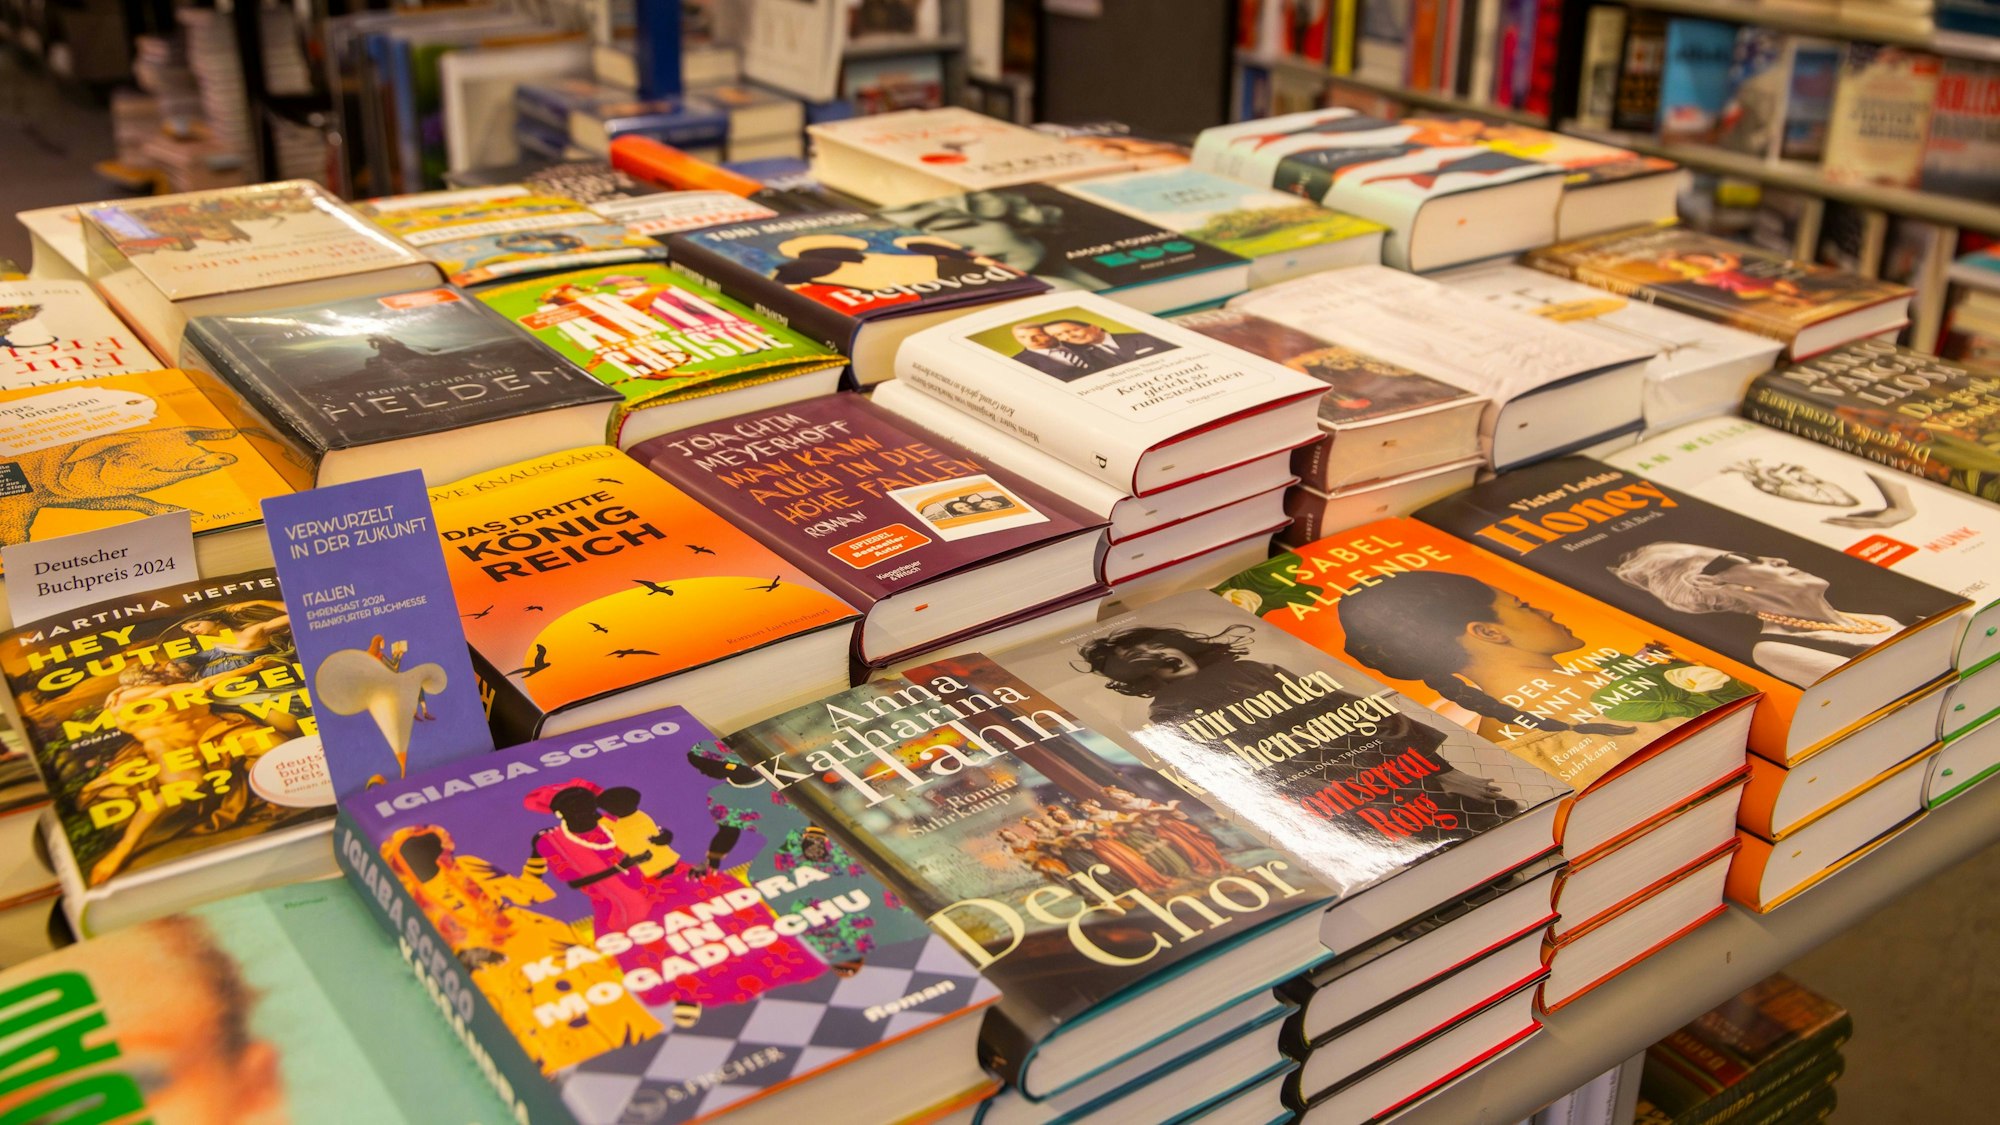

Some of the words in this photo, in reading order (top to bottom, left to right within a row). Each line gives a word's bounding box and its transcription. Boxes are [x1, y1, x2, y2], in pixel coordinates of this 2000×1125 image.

[705, 227, 758, 243] TONI
[762, 211, 868, 234] MORRISON
[827, 265, 1016, 307] Beloved
[6, 336, 124, 361] Frei
[16, 352, 126, 375] Für
[599, 324, 793, 378] CHRISTIE
[1117, 377, 1152, 396] Kein
[1154, 362, 1209, 383] Grund,
[1131, 370, 1245, 412] rumzuschreien
[1144, 378, 1189, 398] gleich
[1192, 372, 1208, 381] so
[0, 418, 89, 443] warzbrenner
[92, 410, 120, 423] und
[15, 396, 100, 419] Jonasson
[20, 411, 82, 431] verliebte
[1751, 408, 1799, 438] LLOSA
[1757, 388, 1846, 438] Versuchung
[9, 439, 38, 450] wie
[41, 435, 55, 444] er
[57, 429, 80, 443] die
[81, 418, 117, 438] Welt
[119, 413, 146, 426] sah
[667, 411, 808, 459] JOACHIM
[694, 419, 849, 473] MEYERHOFF
[1804, 428, 1864, 456] VARGAS
[1850, 424, 1902, 449] große
[1902, 439, 1931, 465] Die
[474, 447, 616, 494] KNAUSGÅRD
[718, 458, 798, 491] MAN
[797, 434, 886, 476] KANN
[747, 468, 832, 506] AUCH
[839, 459, 882, 487] IN
[883, 442, 946, 466] DIE
[1312, 444, 1322, 475] HANSER
[1869, 450, 1926, 477] MARIO
[773, 482, 864, 526] HÖHE
[856, 456, 988, 499] FALLEN
[1509, 487, 1567, 512] Victor
[1563, 470, 1624, 495] Lodato
[284, 504, 395, 541] VERWURZELT
[441, 520, 508, 541] DAS
[509, 490, 616, 527] DRITTE
[457, 504, 641, 563] KÖNIG
[804, 510, 868, 538] ROMAN
[1474, 480, 1679, 556] Honey
[290, 544, 310, 560] IN
[314, 534, 351, 556] DER
[355, 516, 428, 547] ZUKUNFT
[480, 522, 668, 583] REICH
[849, 531, 894, 551] SPIEGEL
[852, 534, 909, 559] Bestseller-
[874, 543, 905, 557] Autor
[1562, 531, 1608, 553] Roman
[1923, 526, 1981, 553] MUNK
[34, 547, 129, 576] Deutscher
[36, 569, 129, 597] Buchpreis
[133, 556, 176, 578] 2024
[876, 560, 922, 581] Kiepenheuer
[1271, 535, 1403, 587] ISABEL
[302, 583, 356, 608] ITALIEN
[1287, 545, 1452, 620] ALLENDE
[1957, 578, 1990, 599] EYNE
[18, 599, 171, 648] MARTINA
[306, 599, 360, 621] EHRENGAST
[361, 594, 386, 607] 2024
[308, 608, 372, 631] FRANKFURTER
[373, 595, 428, 616] BUCHMESSE
[726, 628, 763, 646] Roman
[764, 607, 831, 636] Luchterhand
[26, 624, 137, 672] HEY
[37, 628, 239, 691] GUTEN
[1497, 687, 1581, 741] KENNT
[1581, 649, 1675, 690] MEINEN
[1502, 677, 1556, 709] DER
[1553, 647, 1620, 677] WIND
[240, 687, 313, 721] WI
[824, 673, 969, 735] Anna
[1179, 709, 1237, 744] wir
[1226, 689, 1294, 725] von
[1283, 669, 1346, 707] den
[1568, 676, 1660, 723] NAMEN
[70, 730, 122, 751] ROMAN
[753, 684, 1031, 792] Katharina
[1290, 692, 1401, 750] sangen
[108, 725, 276, 787] GEHT
[297, 716, 319, 736] E
[275, 752, 326, 772] deuts
[278, 762, 320, 780] buch
[374, 760, 539, 818] IGIABA
[539, 720, 682, 769] SCEGO
[832, 708, 1086, 810] Hahn
[1550, 736, 1593, 767] Roman
[1559, 739, 1619, 782] Suhrkamp
[88, 769, 233, 830] DIR?
[283, 769, 325, 788] preis
[945, 777, 1019, 811] Roman
[1283, 746, 1441, 824] ontserrat
[905, 791, 1013, 840] Suhrkamp
[1355, 792, 1460, 844] Roig
[342, 828, 403, 932] IGIABA
[405, 916, 475, 1024] SCEGO
[522, 864, 831, 985] KASSANDRA
[926, 863, 1127, 971] Der
[1067, 859, 1306, 968] Chor
[666, 918, 729, 955] IN
[533, 888, 872, 1030] MOGADISCHU
[862, 979, 957, 1025] Roman
